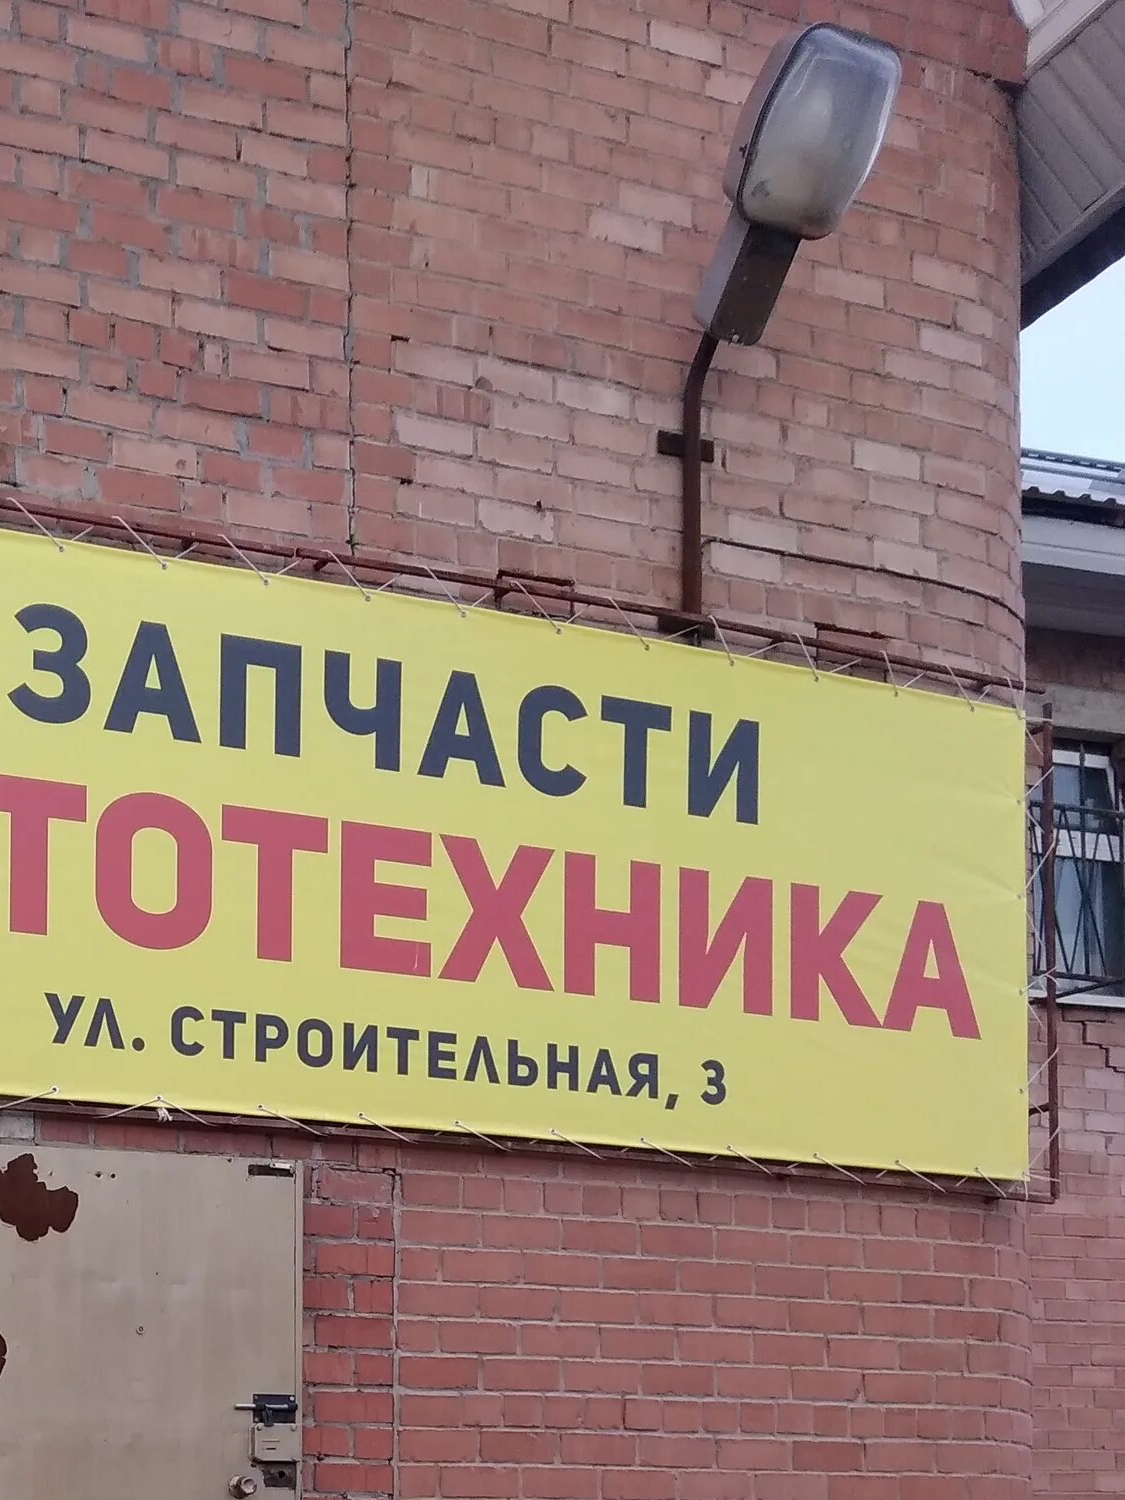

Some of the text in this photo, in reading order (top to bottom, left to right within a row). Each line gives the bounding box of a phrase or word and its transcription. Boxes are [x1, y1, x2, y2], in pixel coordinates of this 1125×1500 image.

[8, 603, 762, 826] ЗАПЧАСТИ
[45, 992, 729, 1111] УЛ. СТРОИТЕЛЬНАЯ, 3
